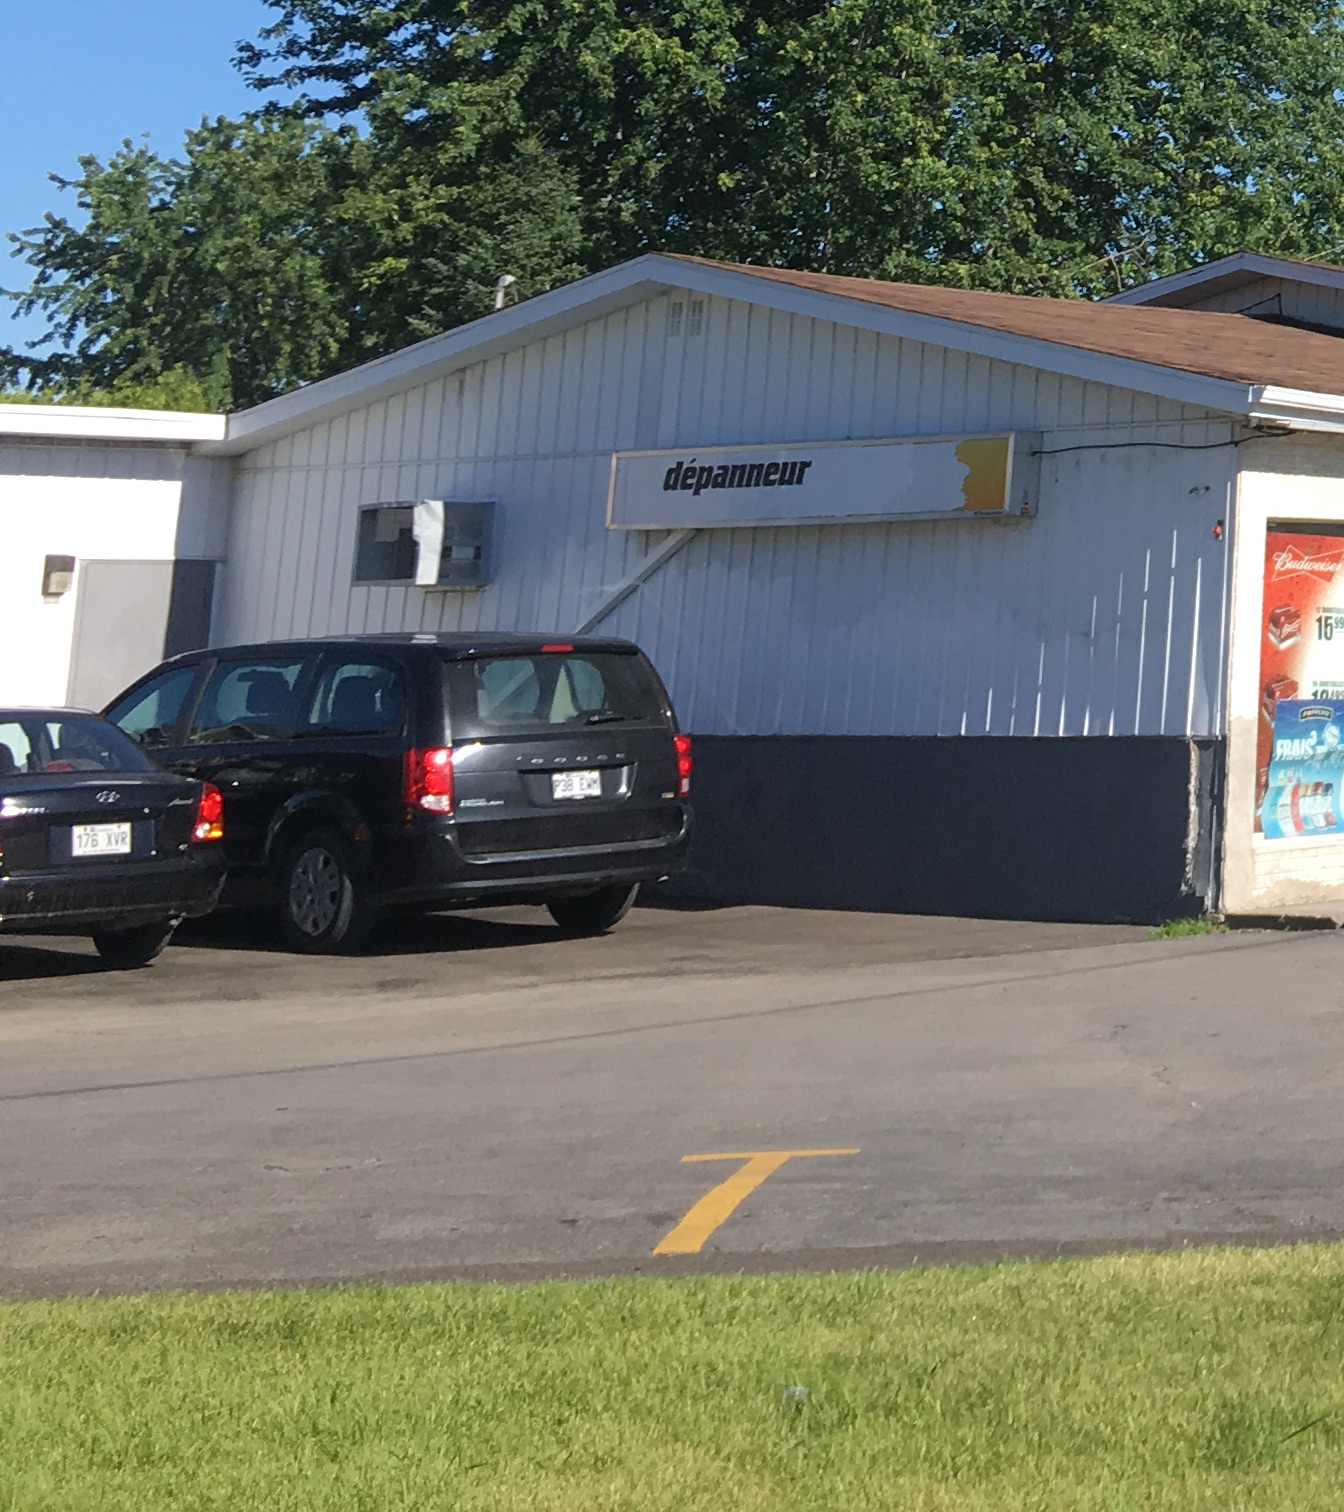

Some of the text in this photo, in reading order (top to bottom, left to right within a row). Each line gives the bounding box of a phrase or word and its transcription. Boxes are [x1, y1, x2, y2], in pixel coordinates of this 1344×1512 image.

[662, 457, 813, 496] dépanneur
[1272, 551, 1344, 573] Budweiser
[76, 831, 128, 849] 176 XVR
